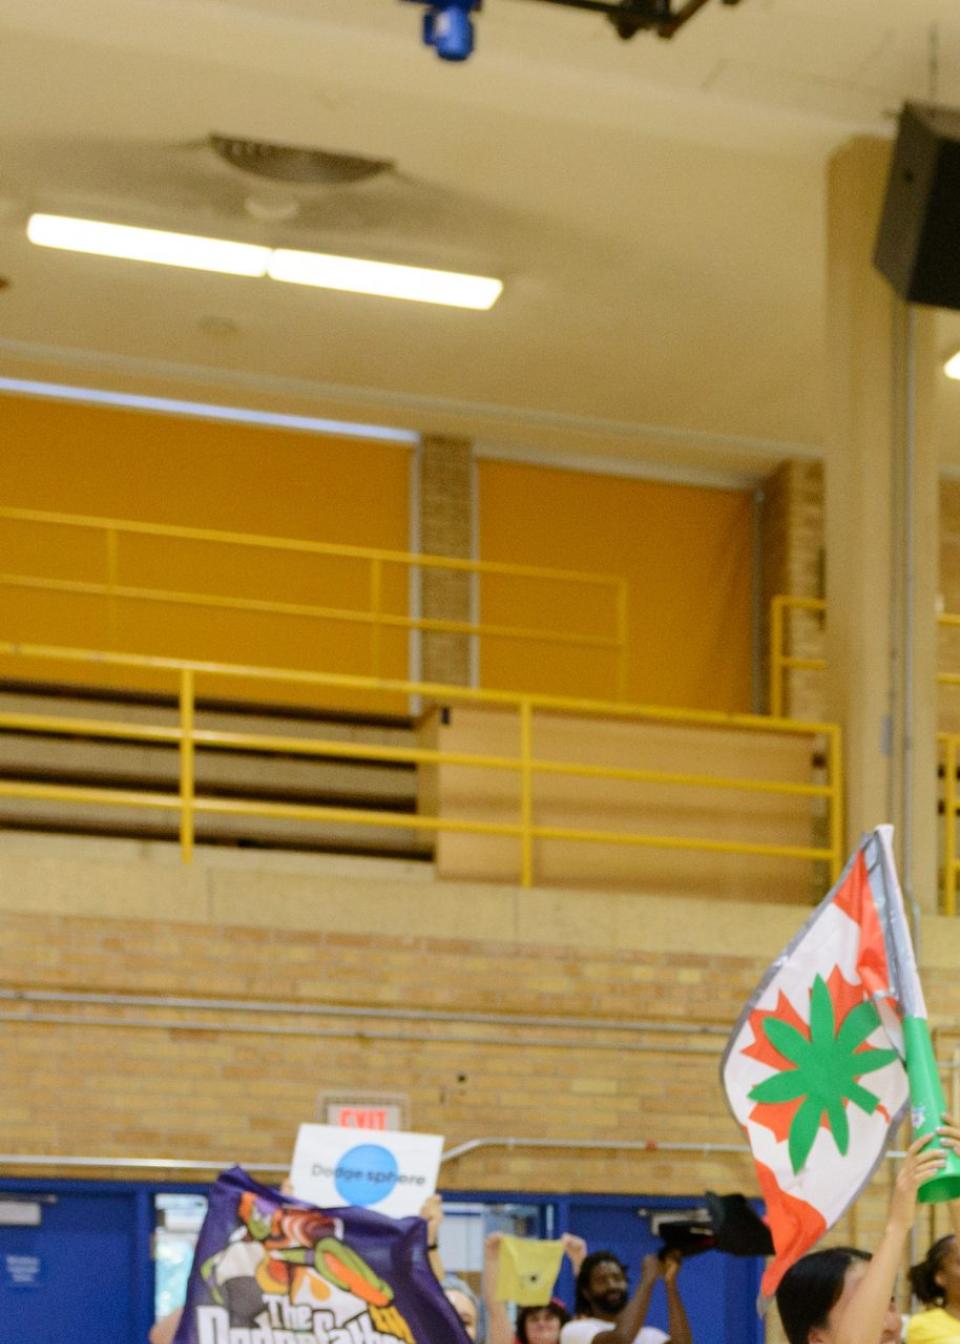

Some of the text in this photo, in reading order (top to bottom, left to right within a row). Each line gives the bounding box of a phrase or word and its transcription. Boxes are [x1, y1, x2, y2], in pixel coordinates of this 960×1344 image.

[311, 1163, 426, 1186] Dodge sphere
[262, 1294, 312, 1330] The
